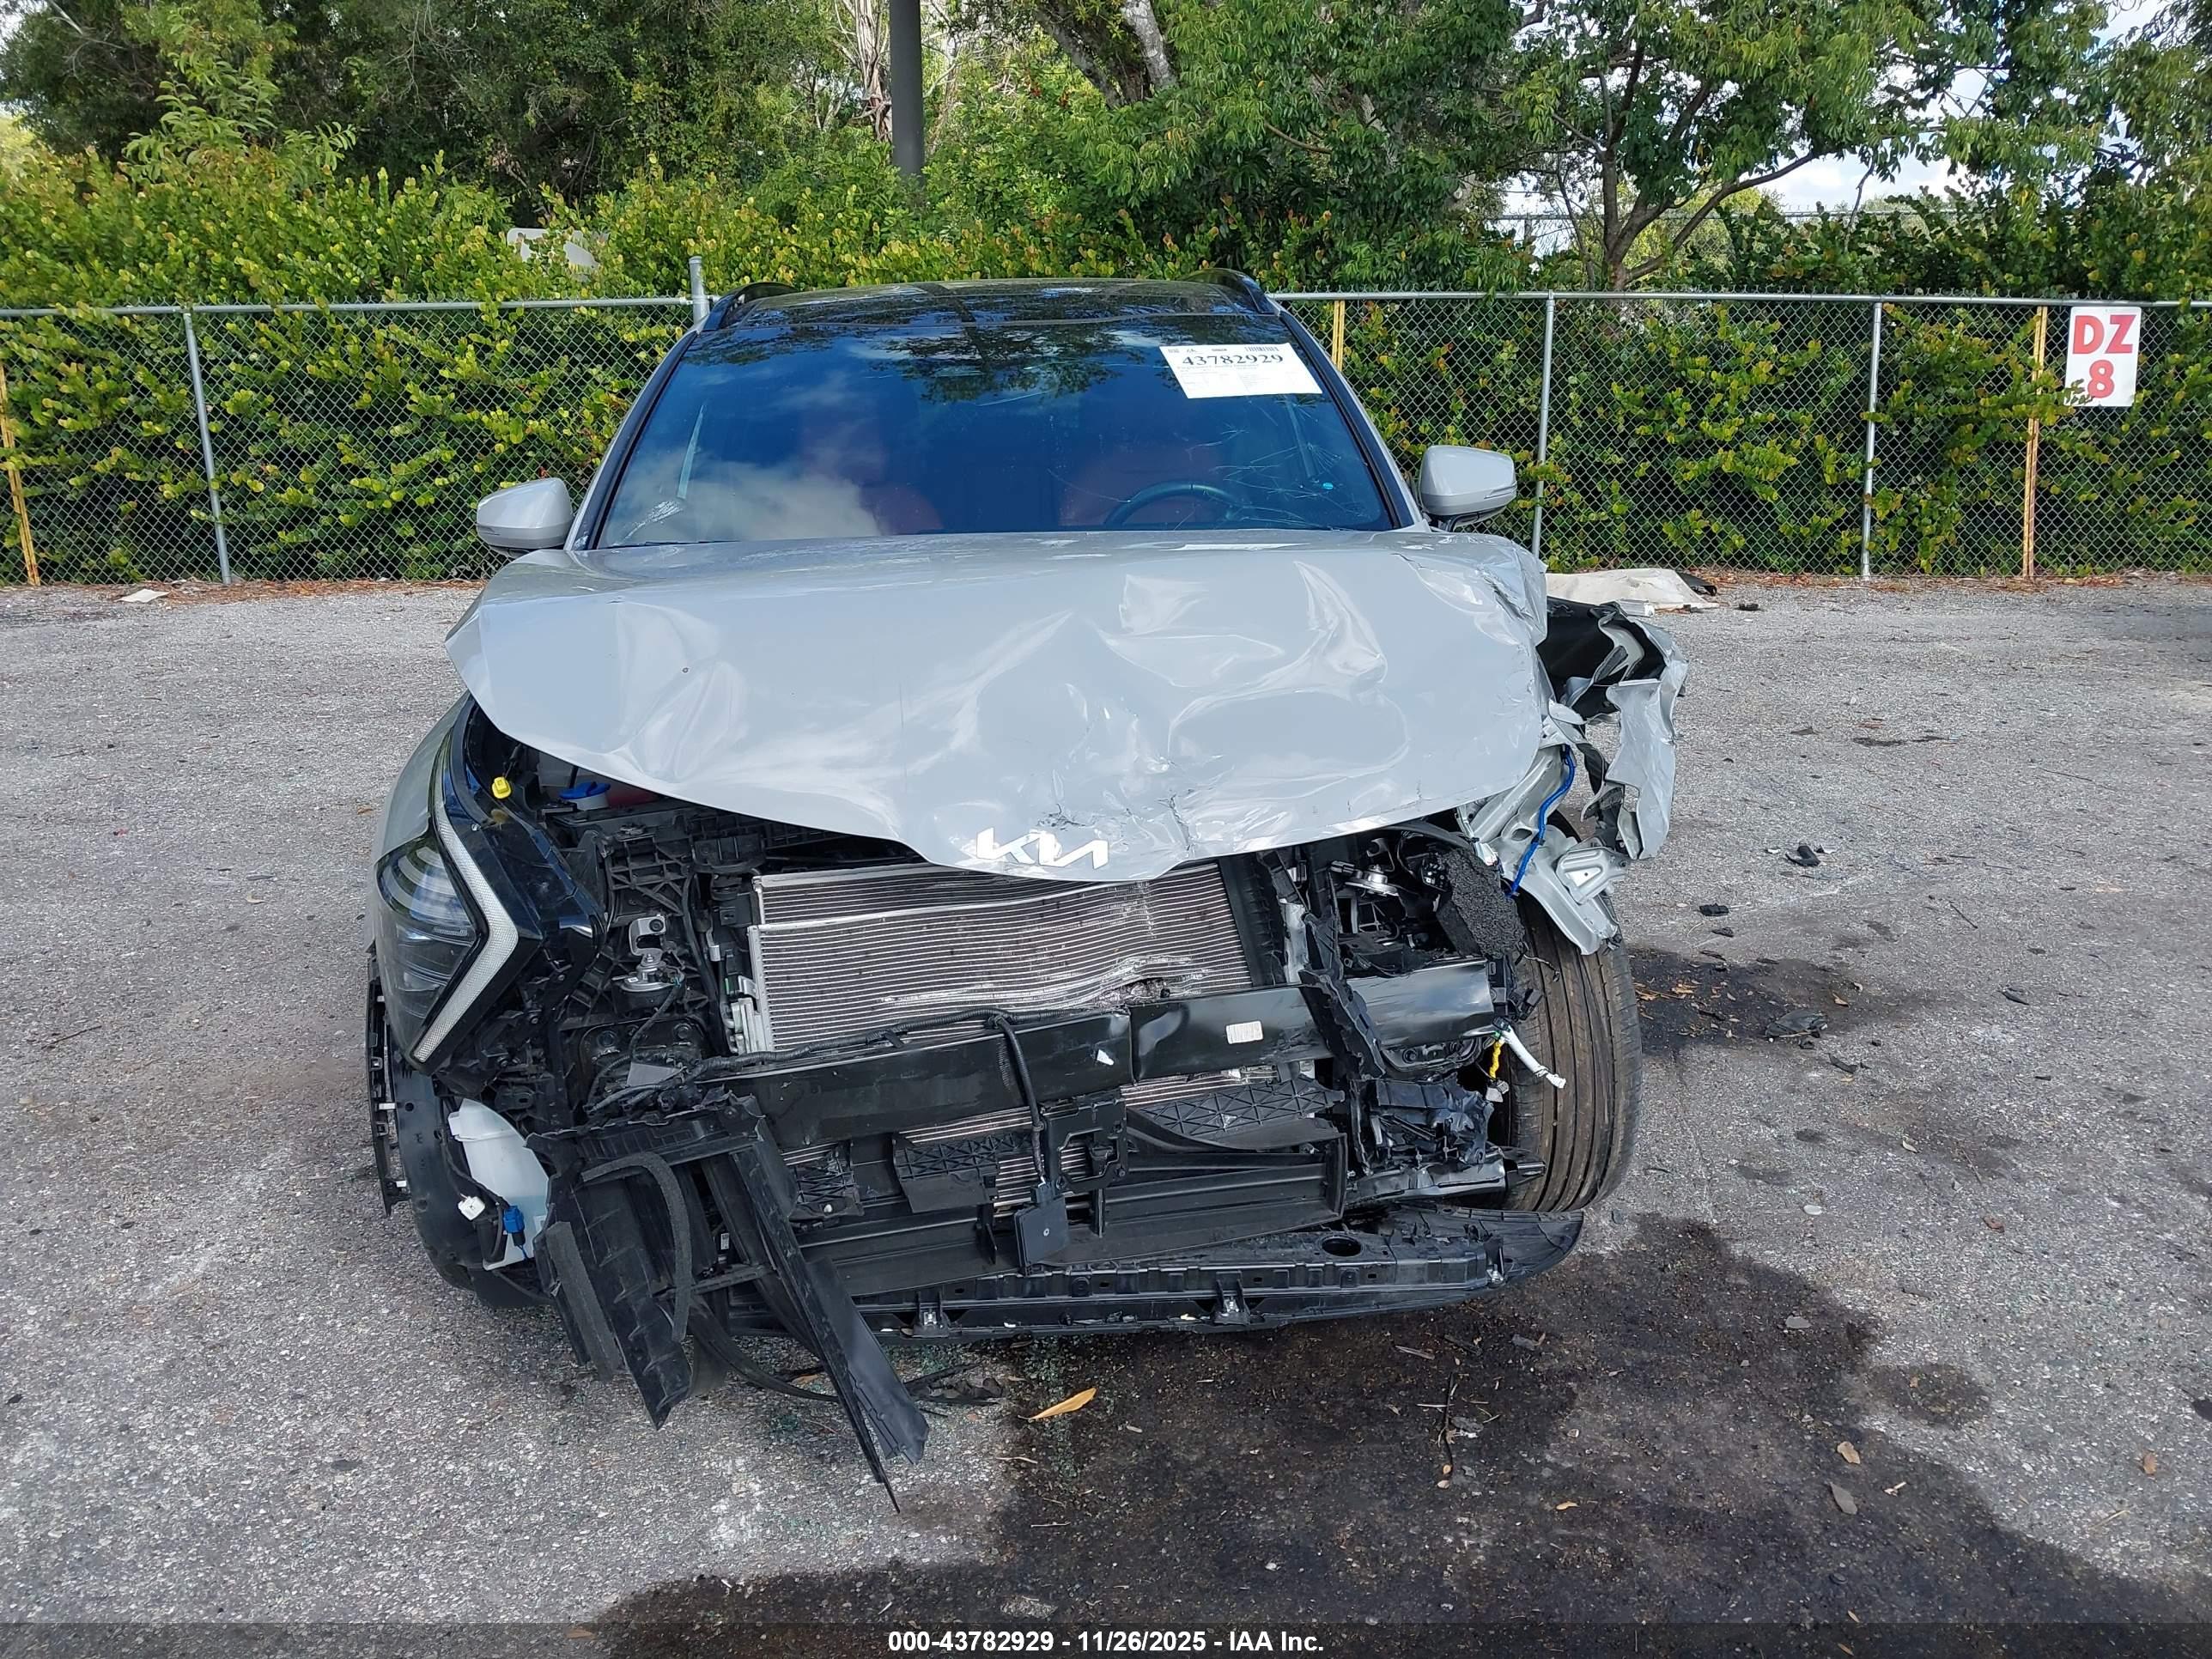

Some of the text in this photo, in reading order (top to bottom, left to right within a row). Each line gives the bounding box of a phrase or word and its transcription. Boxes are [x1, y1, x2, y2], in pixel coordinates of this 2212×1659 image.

[2073, 314, 2136, 355] DZ
[1182, 354, 1284, 366] 43782929
[2087, 359, 2115, 398] 8
[975, 827, 1109, 870] KIA
